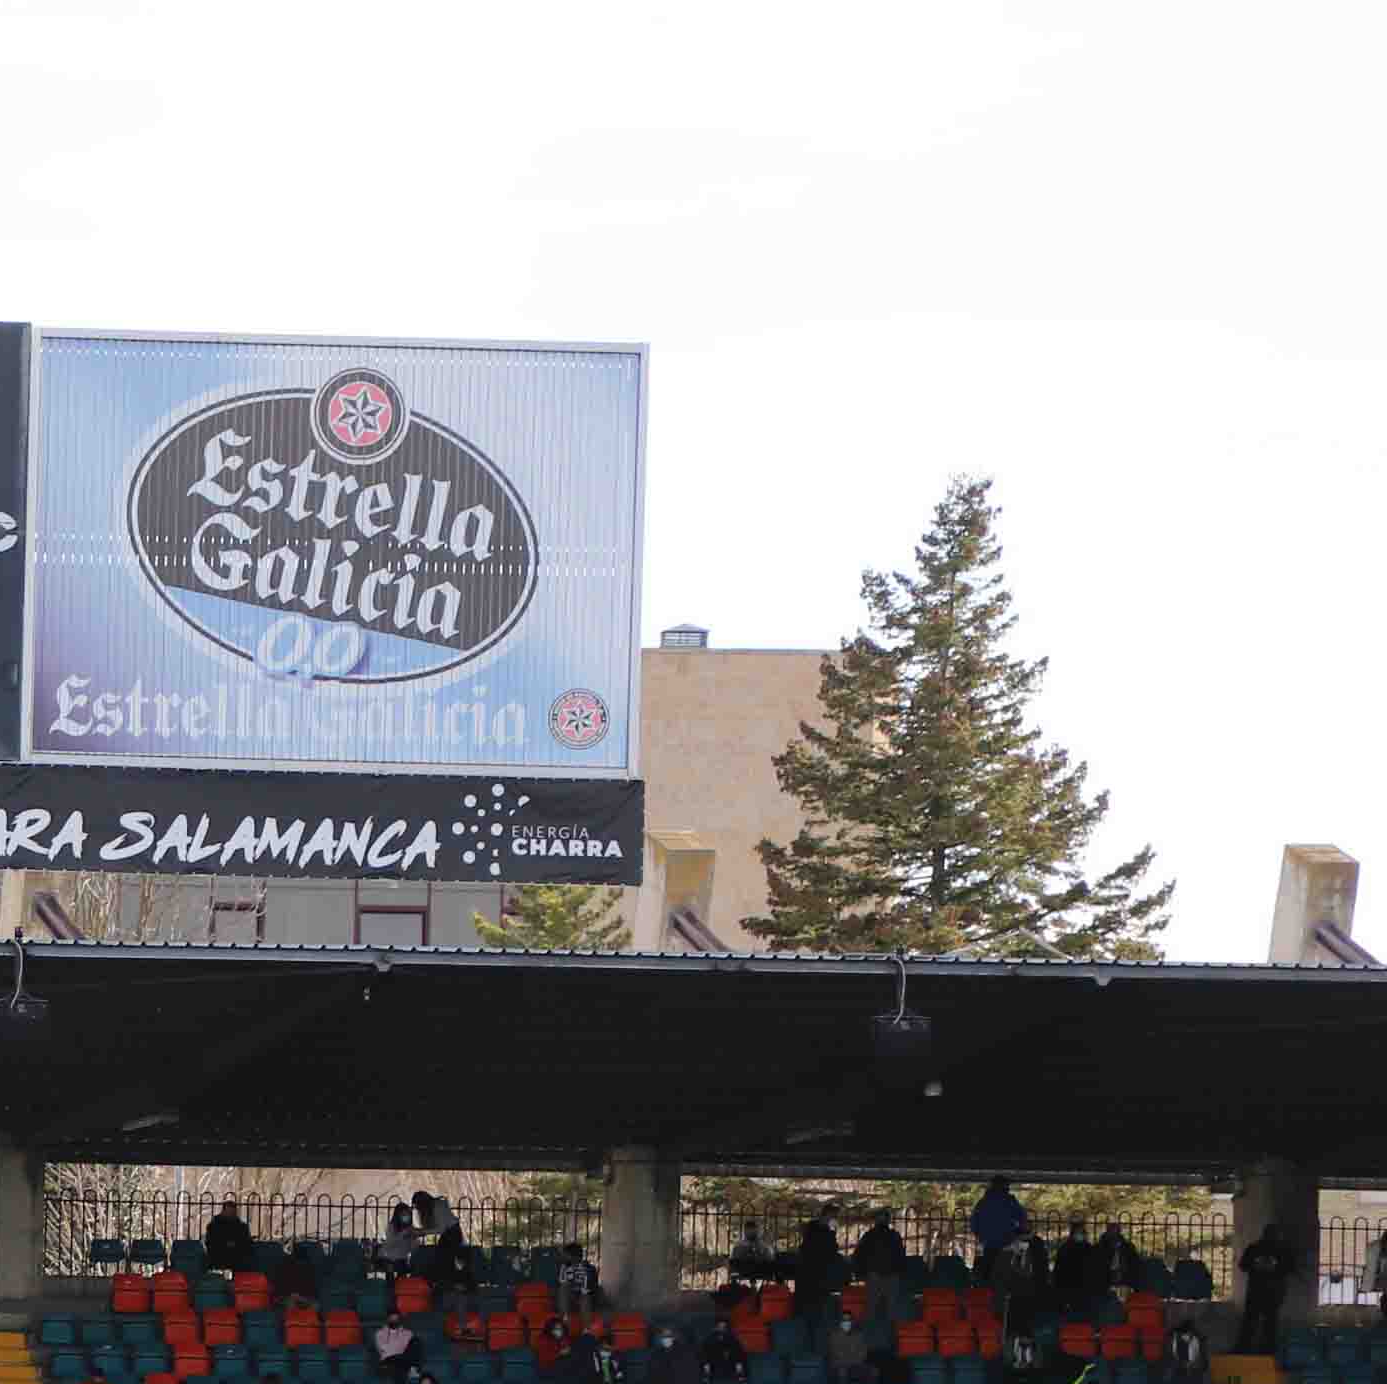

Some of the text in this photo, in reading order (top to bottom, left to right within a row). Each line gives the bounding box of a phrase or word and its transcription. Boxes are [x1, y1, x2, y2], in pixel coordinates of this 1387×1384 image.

[186, 428, 494, 562] Estrella
[190, 511, 461, 640] Galicia
[49, 672, 295, 741] Estrella
[99, 810, 442, 872] SALAMANCA
[511, 822, 589, 840] ENERGÍA
[511, 838, 624, 859] CHARRA
